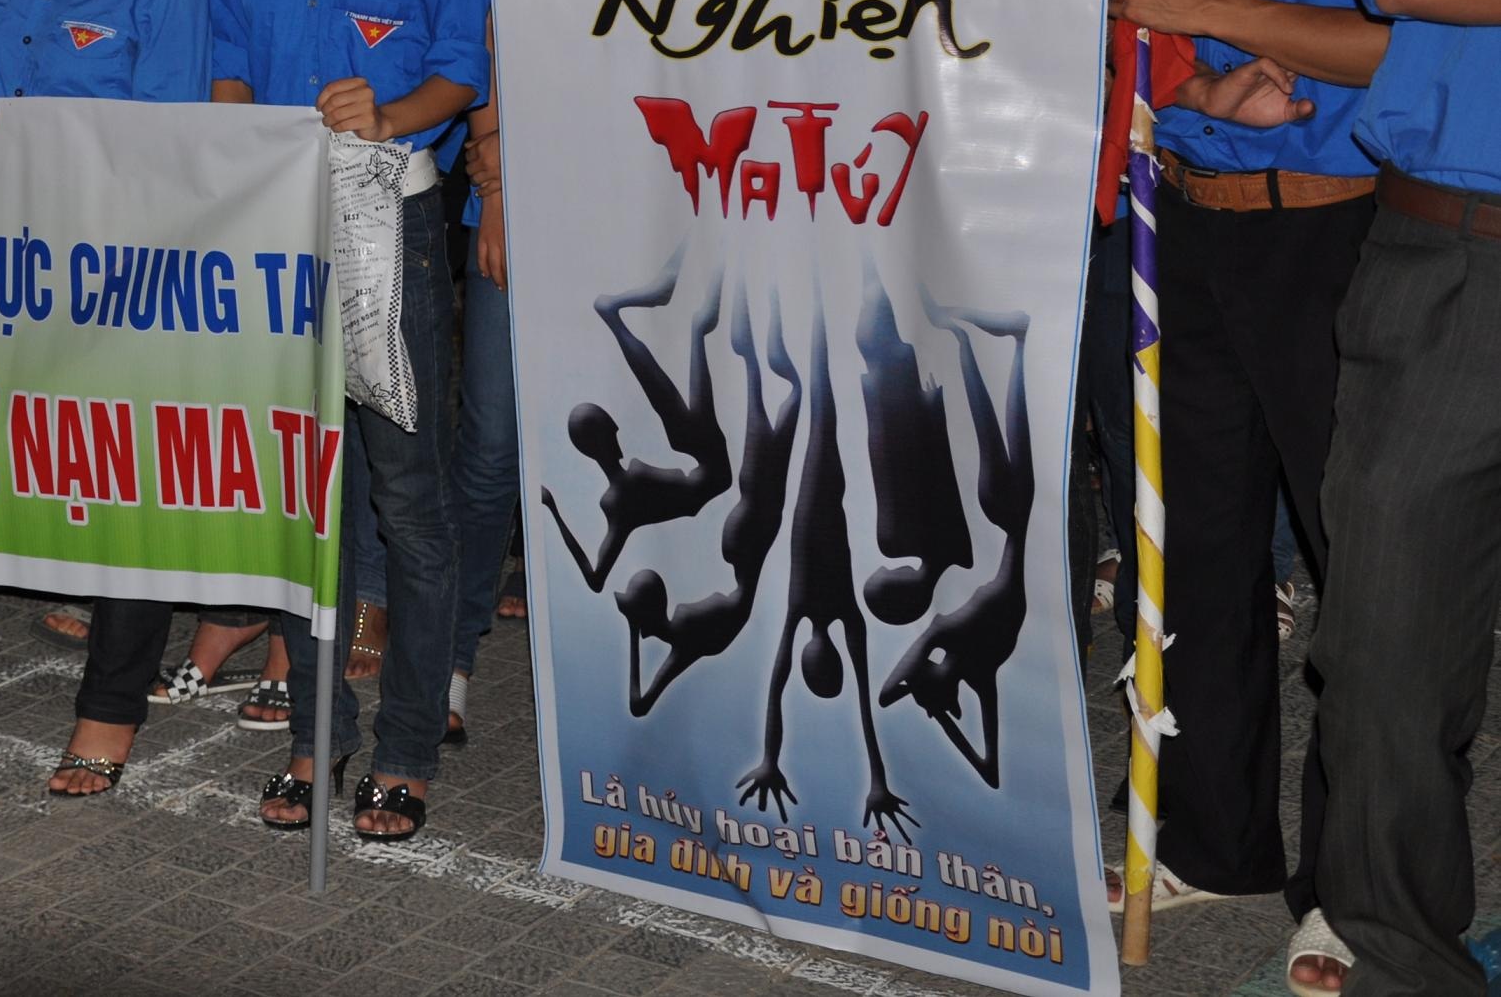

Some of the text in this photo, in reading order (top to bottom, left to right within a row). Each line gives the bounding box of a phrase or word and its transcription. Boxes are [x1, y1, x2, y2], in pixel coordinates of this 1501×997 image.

[70, 243, 239, 334] CHUNG
[9, 391, 141, 525] NẠN
[154, 403, 265, 514] MA
[580, 770, 1056, 919] Là hủy hoại bản thân,
[594, 822, 1064, 965] gia đình và giống nòi
